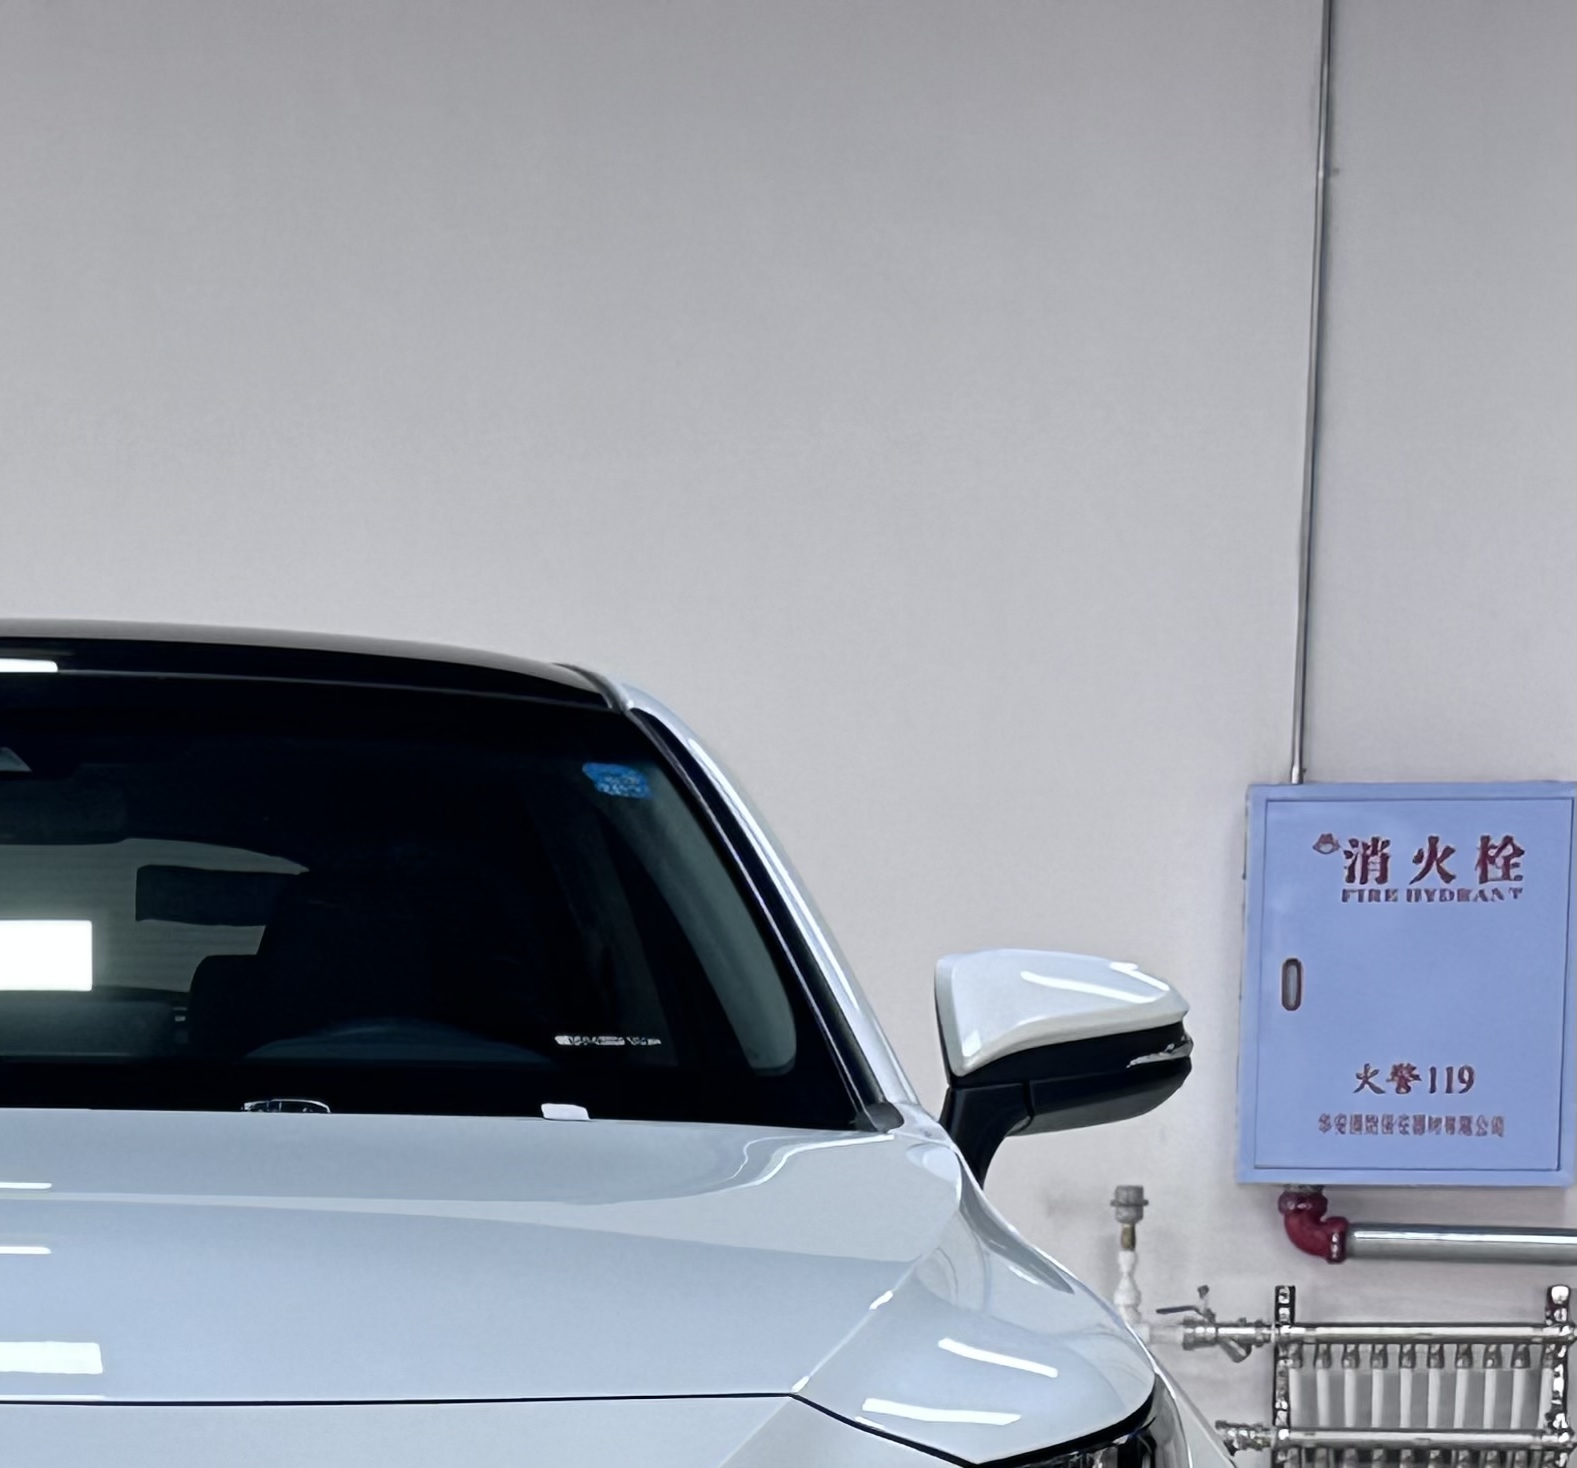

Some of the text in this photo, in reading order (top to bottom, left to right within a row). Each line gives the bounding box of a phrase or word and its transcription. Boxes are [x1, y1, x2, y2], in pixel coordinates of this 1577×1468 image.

[1342, 834, 1525, 885] 消火栓
[1341, 887, 1523, 903] FIRE HYDRANT
